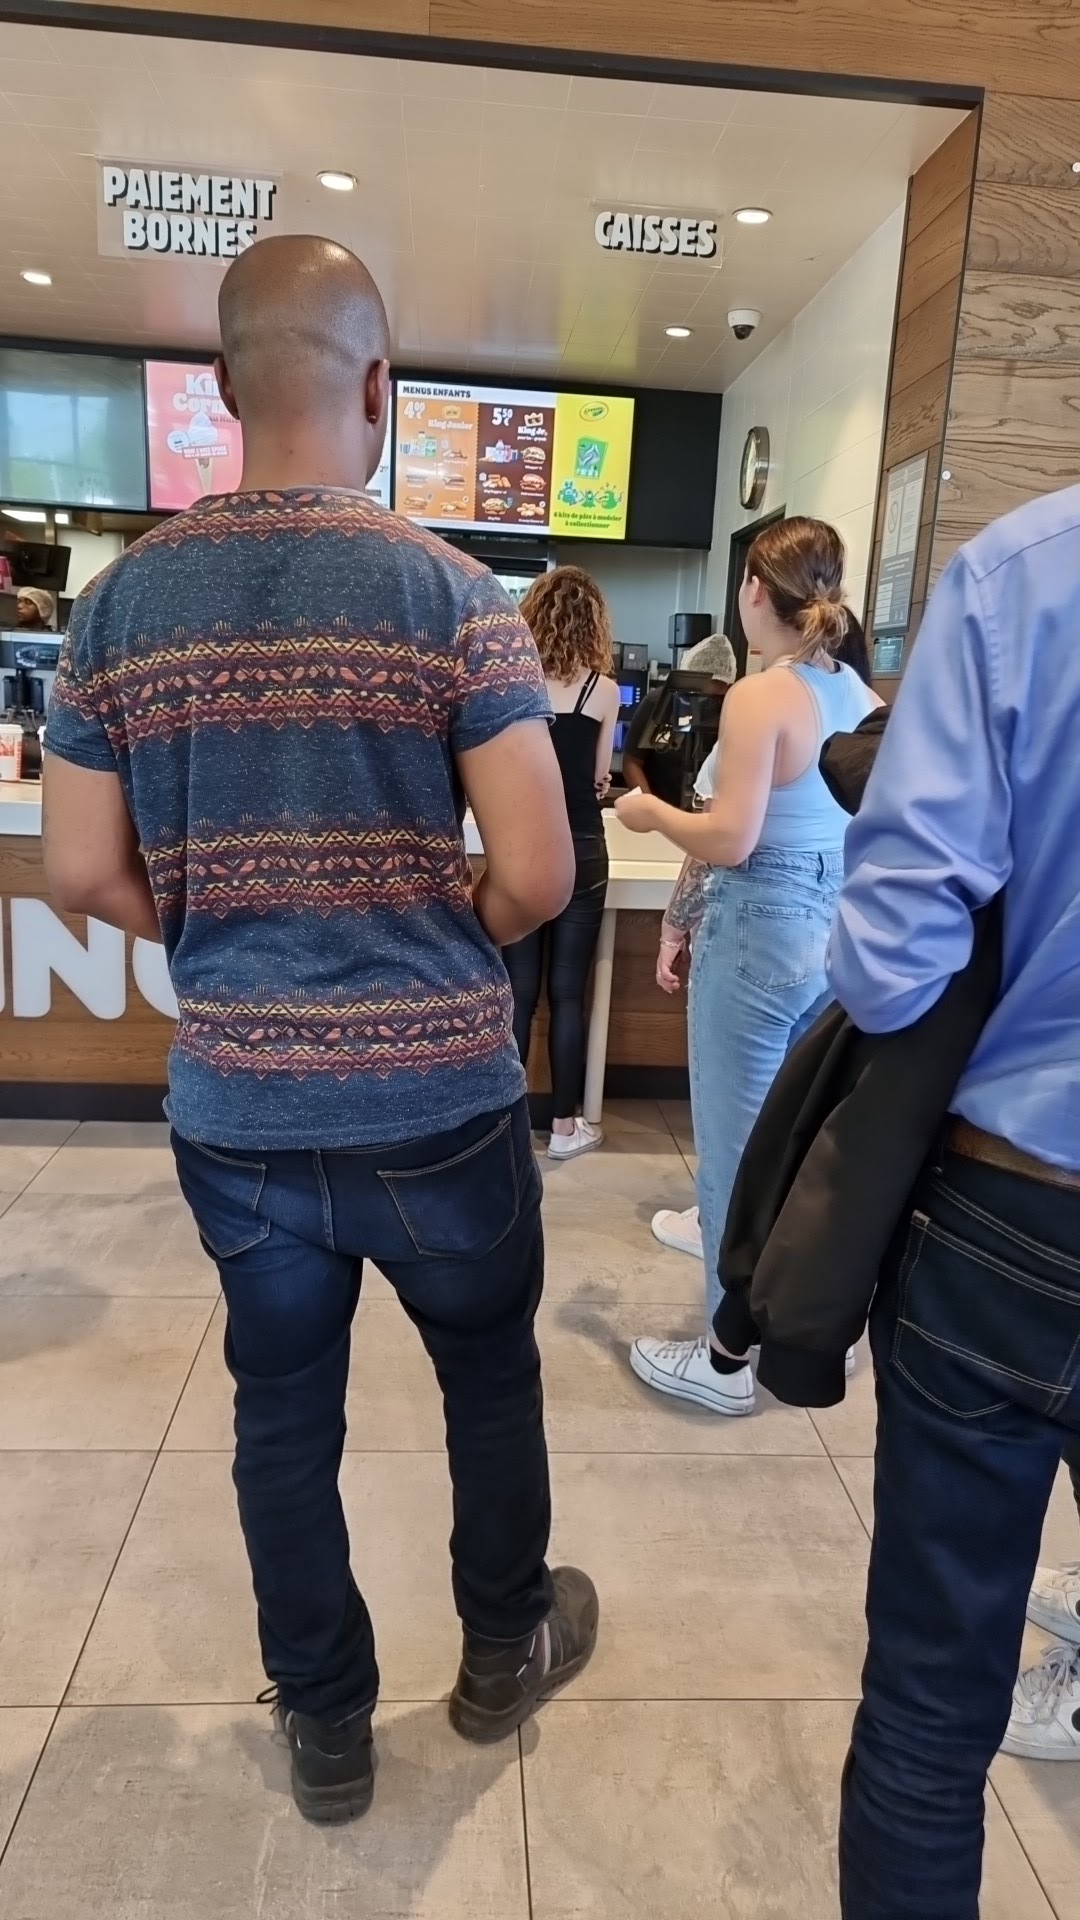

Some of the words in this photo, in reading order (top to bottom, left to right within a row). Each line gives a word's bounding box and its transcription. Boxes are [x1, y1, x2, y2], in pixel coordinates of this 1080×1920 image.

[103, 166, 276, 220] PAIEMENT
[123, 211, 257, 259] BORNES
[595, 212, 717, 258] CAISSES
[403, 386, 432, 396] MENUS
[433, 388, 471, 398] ENFANTS
[518, 426, 536, 436] King
